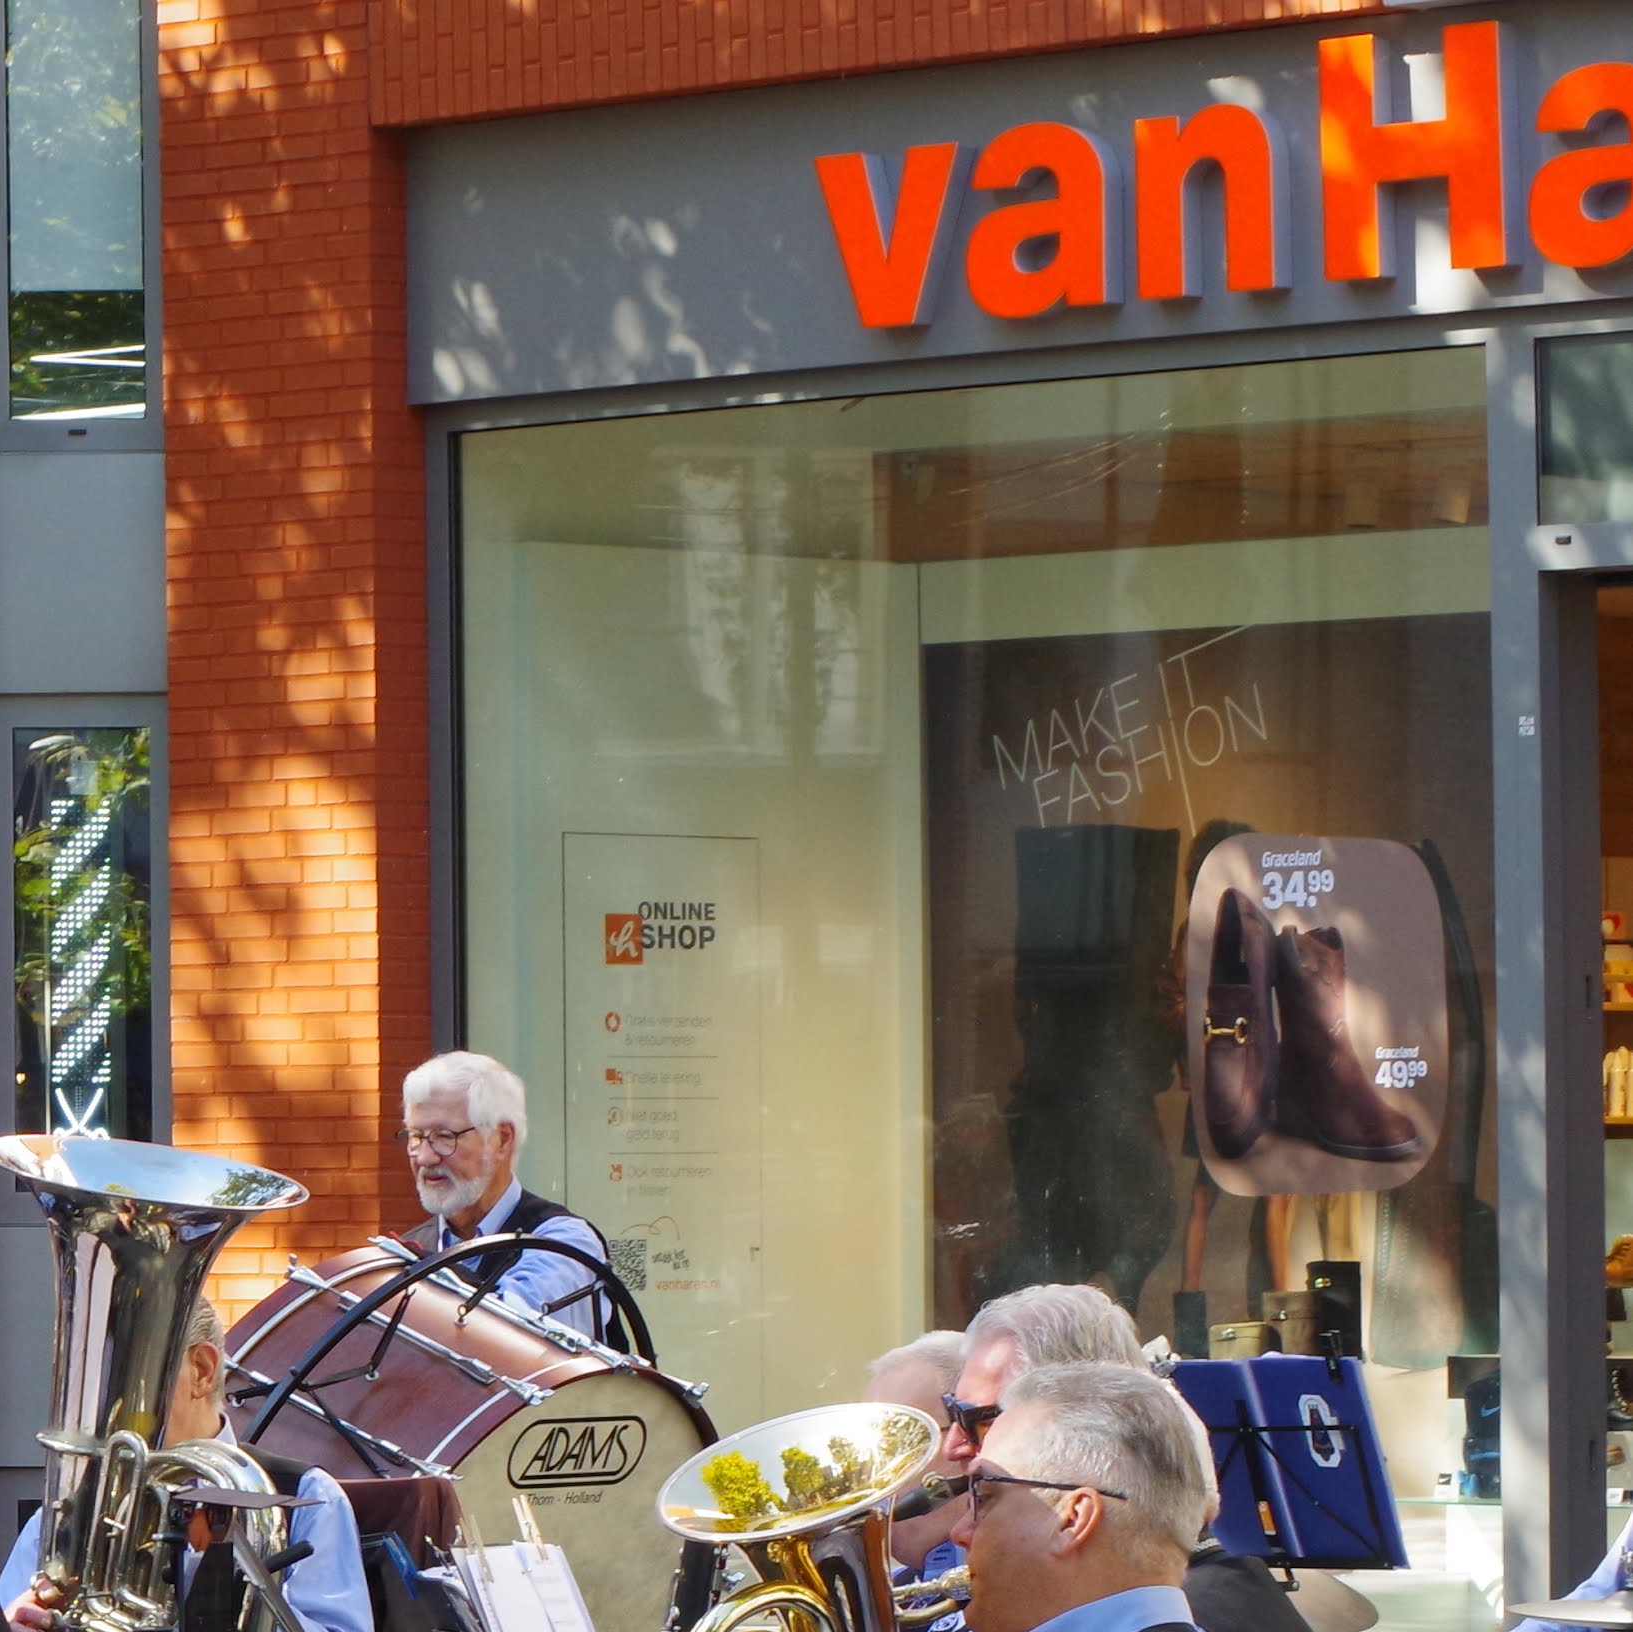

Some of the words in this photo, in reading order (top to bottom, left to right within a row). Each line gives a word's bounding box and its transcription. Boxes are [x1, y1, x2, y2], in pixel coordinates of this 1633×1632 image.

[1158, 624, 1255, 720] IT
[993, 673, 1149, 790] MAKE
[1033, 683, 1267, 837] FASHION
[1262, 850, 1322, 867] Graceland
[1262, 869, 1334, 909] 34.99
[638, 902, 715, 920] ONLINE
[641, 924, 715, 949] SHOP
[1375, 1046, 1419, 1058] Graceland
[1375, 1061, 1427, 1088] 49.99
[519, 1425, 630, 1481] ADAMS
[566, 1491, 602, 1505] Holland
